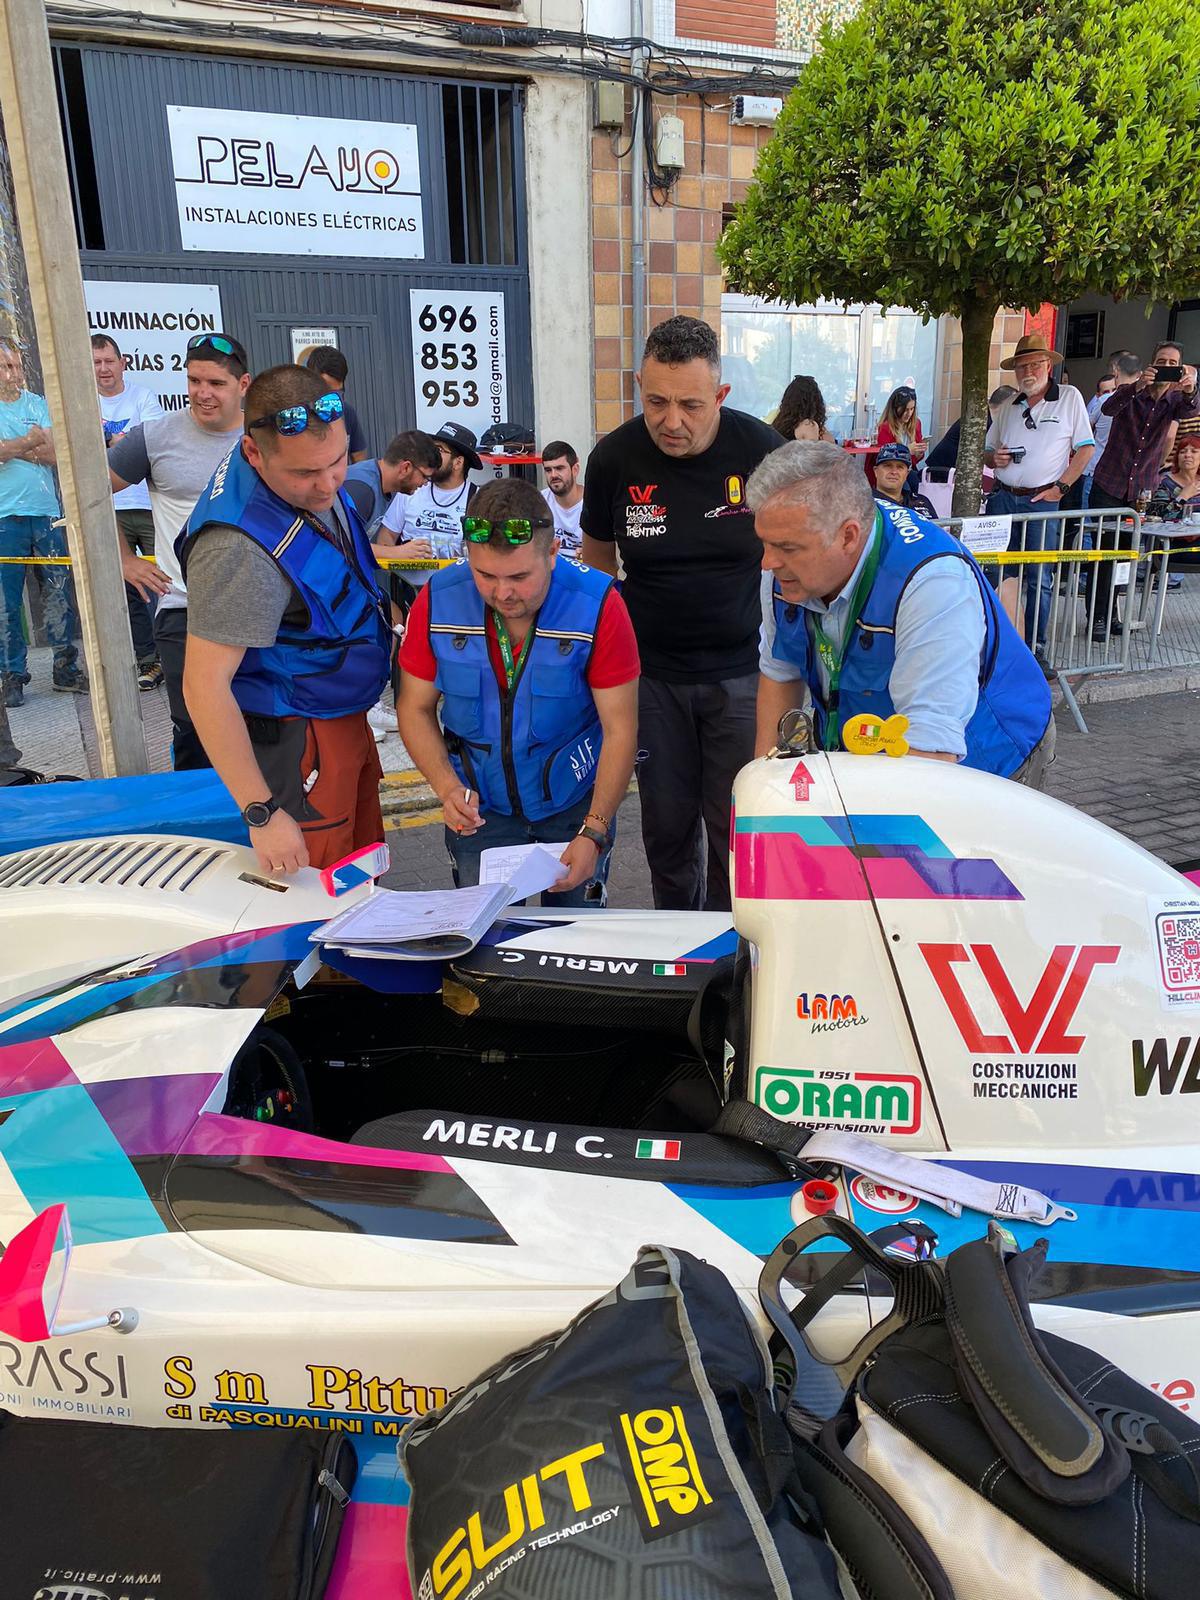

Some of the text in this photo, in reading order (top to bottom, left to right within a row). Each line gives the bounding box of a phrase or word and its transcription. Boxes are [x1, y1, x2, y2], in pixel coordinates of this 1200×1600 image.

[197, 136, 400, 194] PELAYO
[185, 206, 417, 232] INSTALACIONES ELÉCTRICAS
[418, 304, 477, 333] 696
[421, 343, 478, 371] 853
[488, 305, 503, 424] dad@gmail.com
[422, 380, 479, 407] 953
[626, 524, 667, 538] TRENTINO
[977, 520, 997, 529] AVISO
[497, 951, 639, 975] MERLI C.
[796, 993, 858, 1020] LRM
[917, 943, 1122, 1054] CVC
[811, 1015, 869, 1034] motors
[818, 1070, 851, 1080] 1951
[972, 1063, 1077, 1079] COSTRUZIONI
[764, 1079, 909, 1121] ORAM
[973, 1083, 1078, 1098] MECCANICHE
[422, 1119, 614, 1159] MERLI C.
[164, 1355, 464, 1416] S m Pittu
[33, 1398, 131, 1417] IMMOBILIARI
[166, 1404, 192, 1420] di
[200, 1406, 363, 1434] PASQUALINI
[633, 1408, 699, 1515] OMP
[432, 1442, 605, 1600] SUIT
[486, 1548, 526, 1584] RACING
[528, 1505, 621, 1551] TECHNOLOGY
[44, 1568, 162, 1584] www.pratic.it
